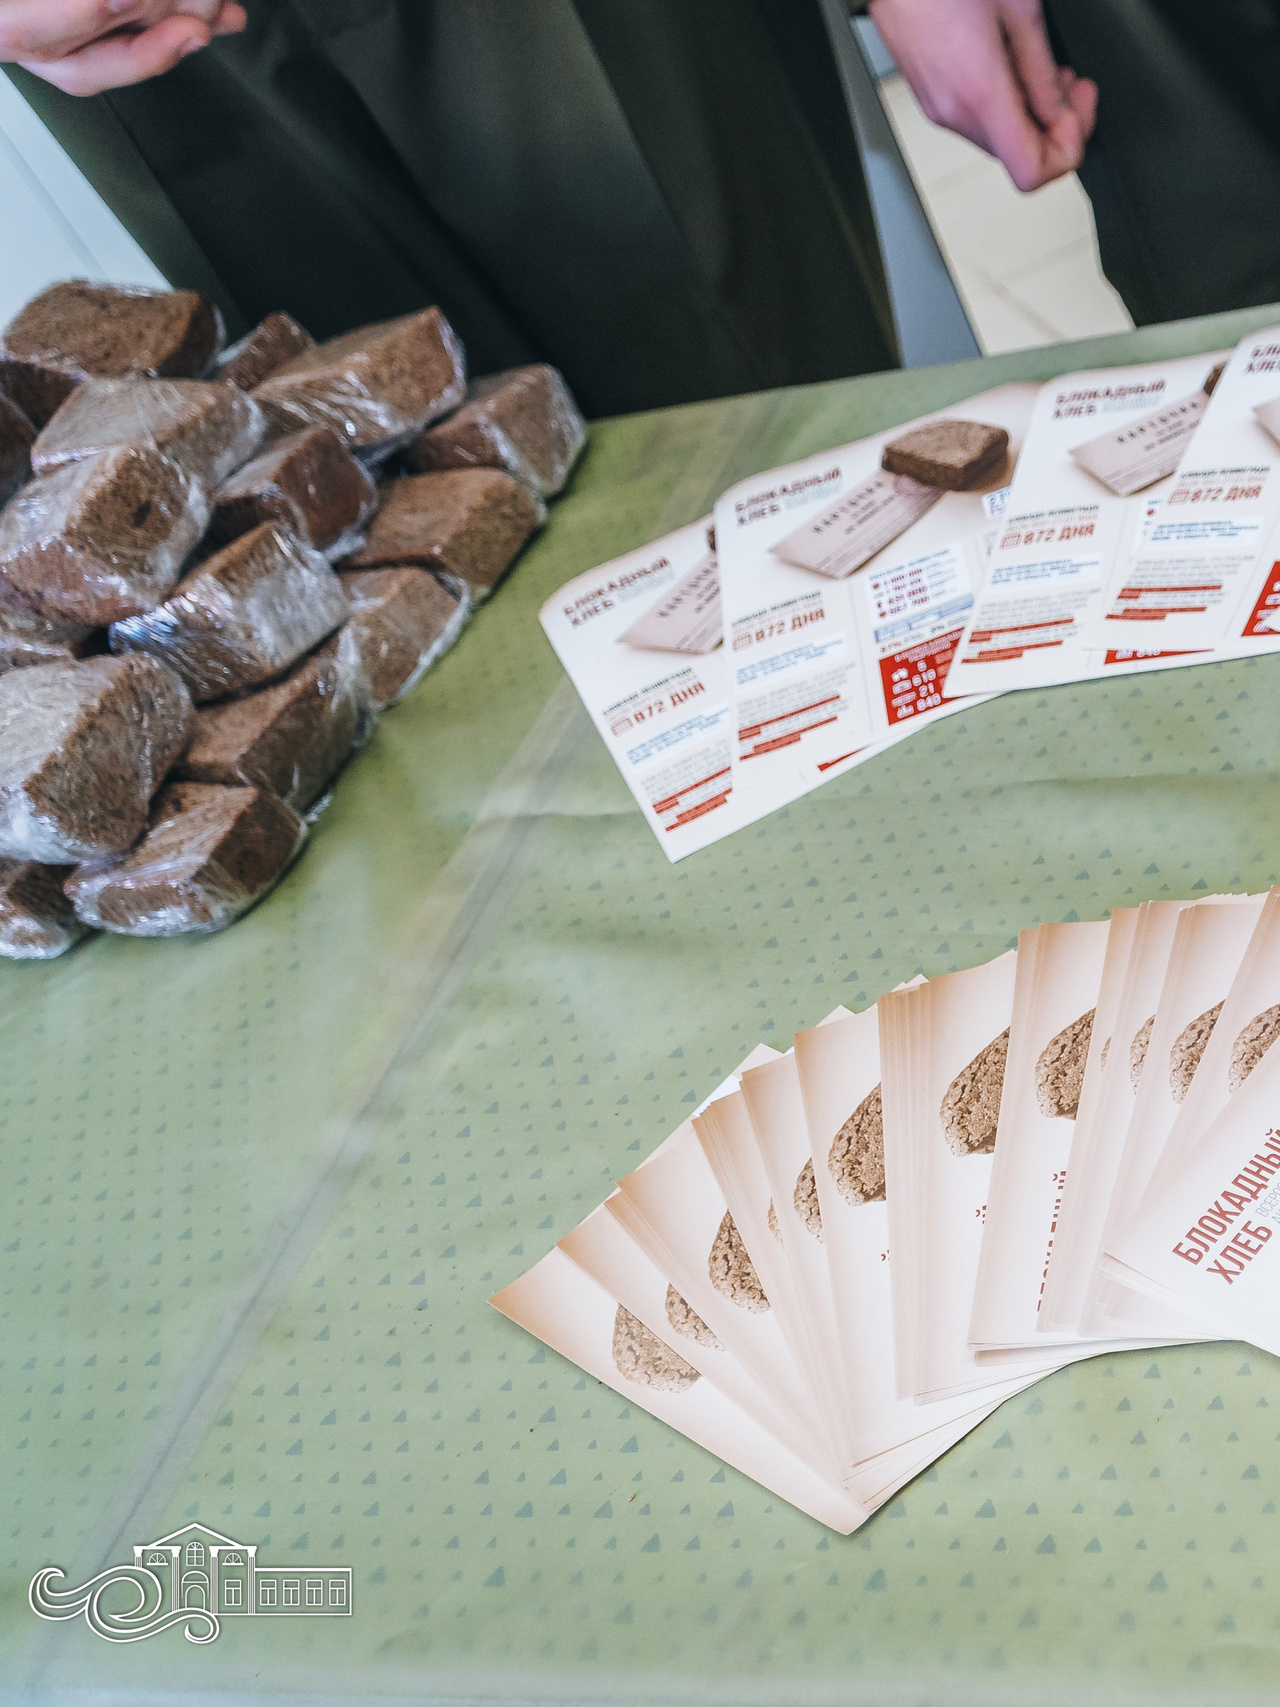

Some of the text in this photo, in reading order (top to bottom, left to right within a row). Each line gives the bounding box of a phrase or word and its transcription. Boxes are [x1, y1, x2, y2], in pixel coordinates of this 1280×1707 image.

[917, 659, 927, 672] 5
[912, 668, 937, 687] 610
[919, 682, 935, 698] 21
[916, 692, 942, 712] 840
[1206, 1220, 1273, 1285] ХЛЕБ
